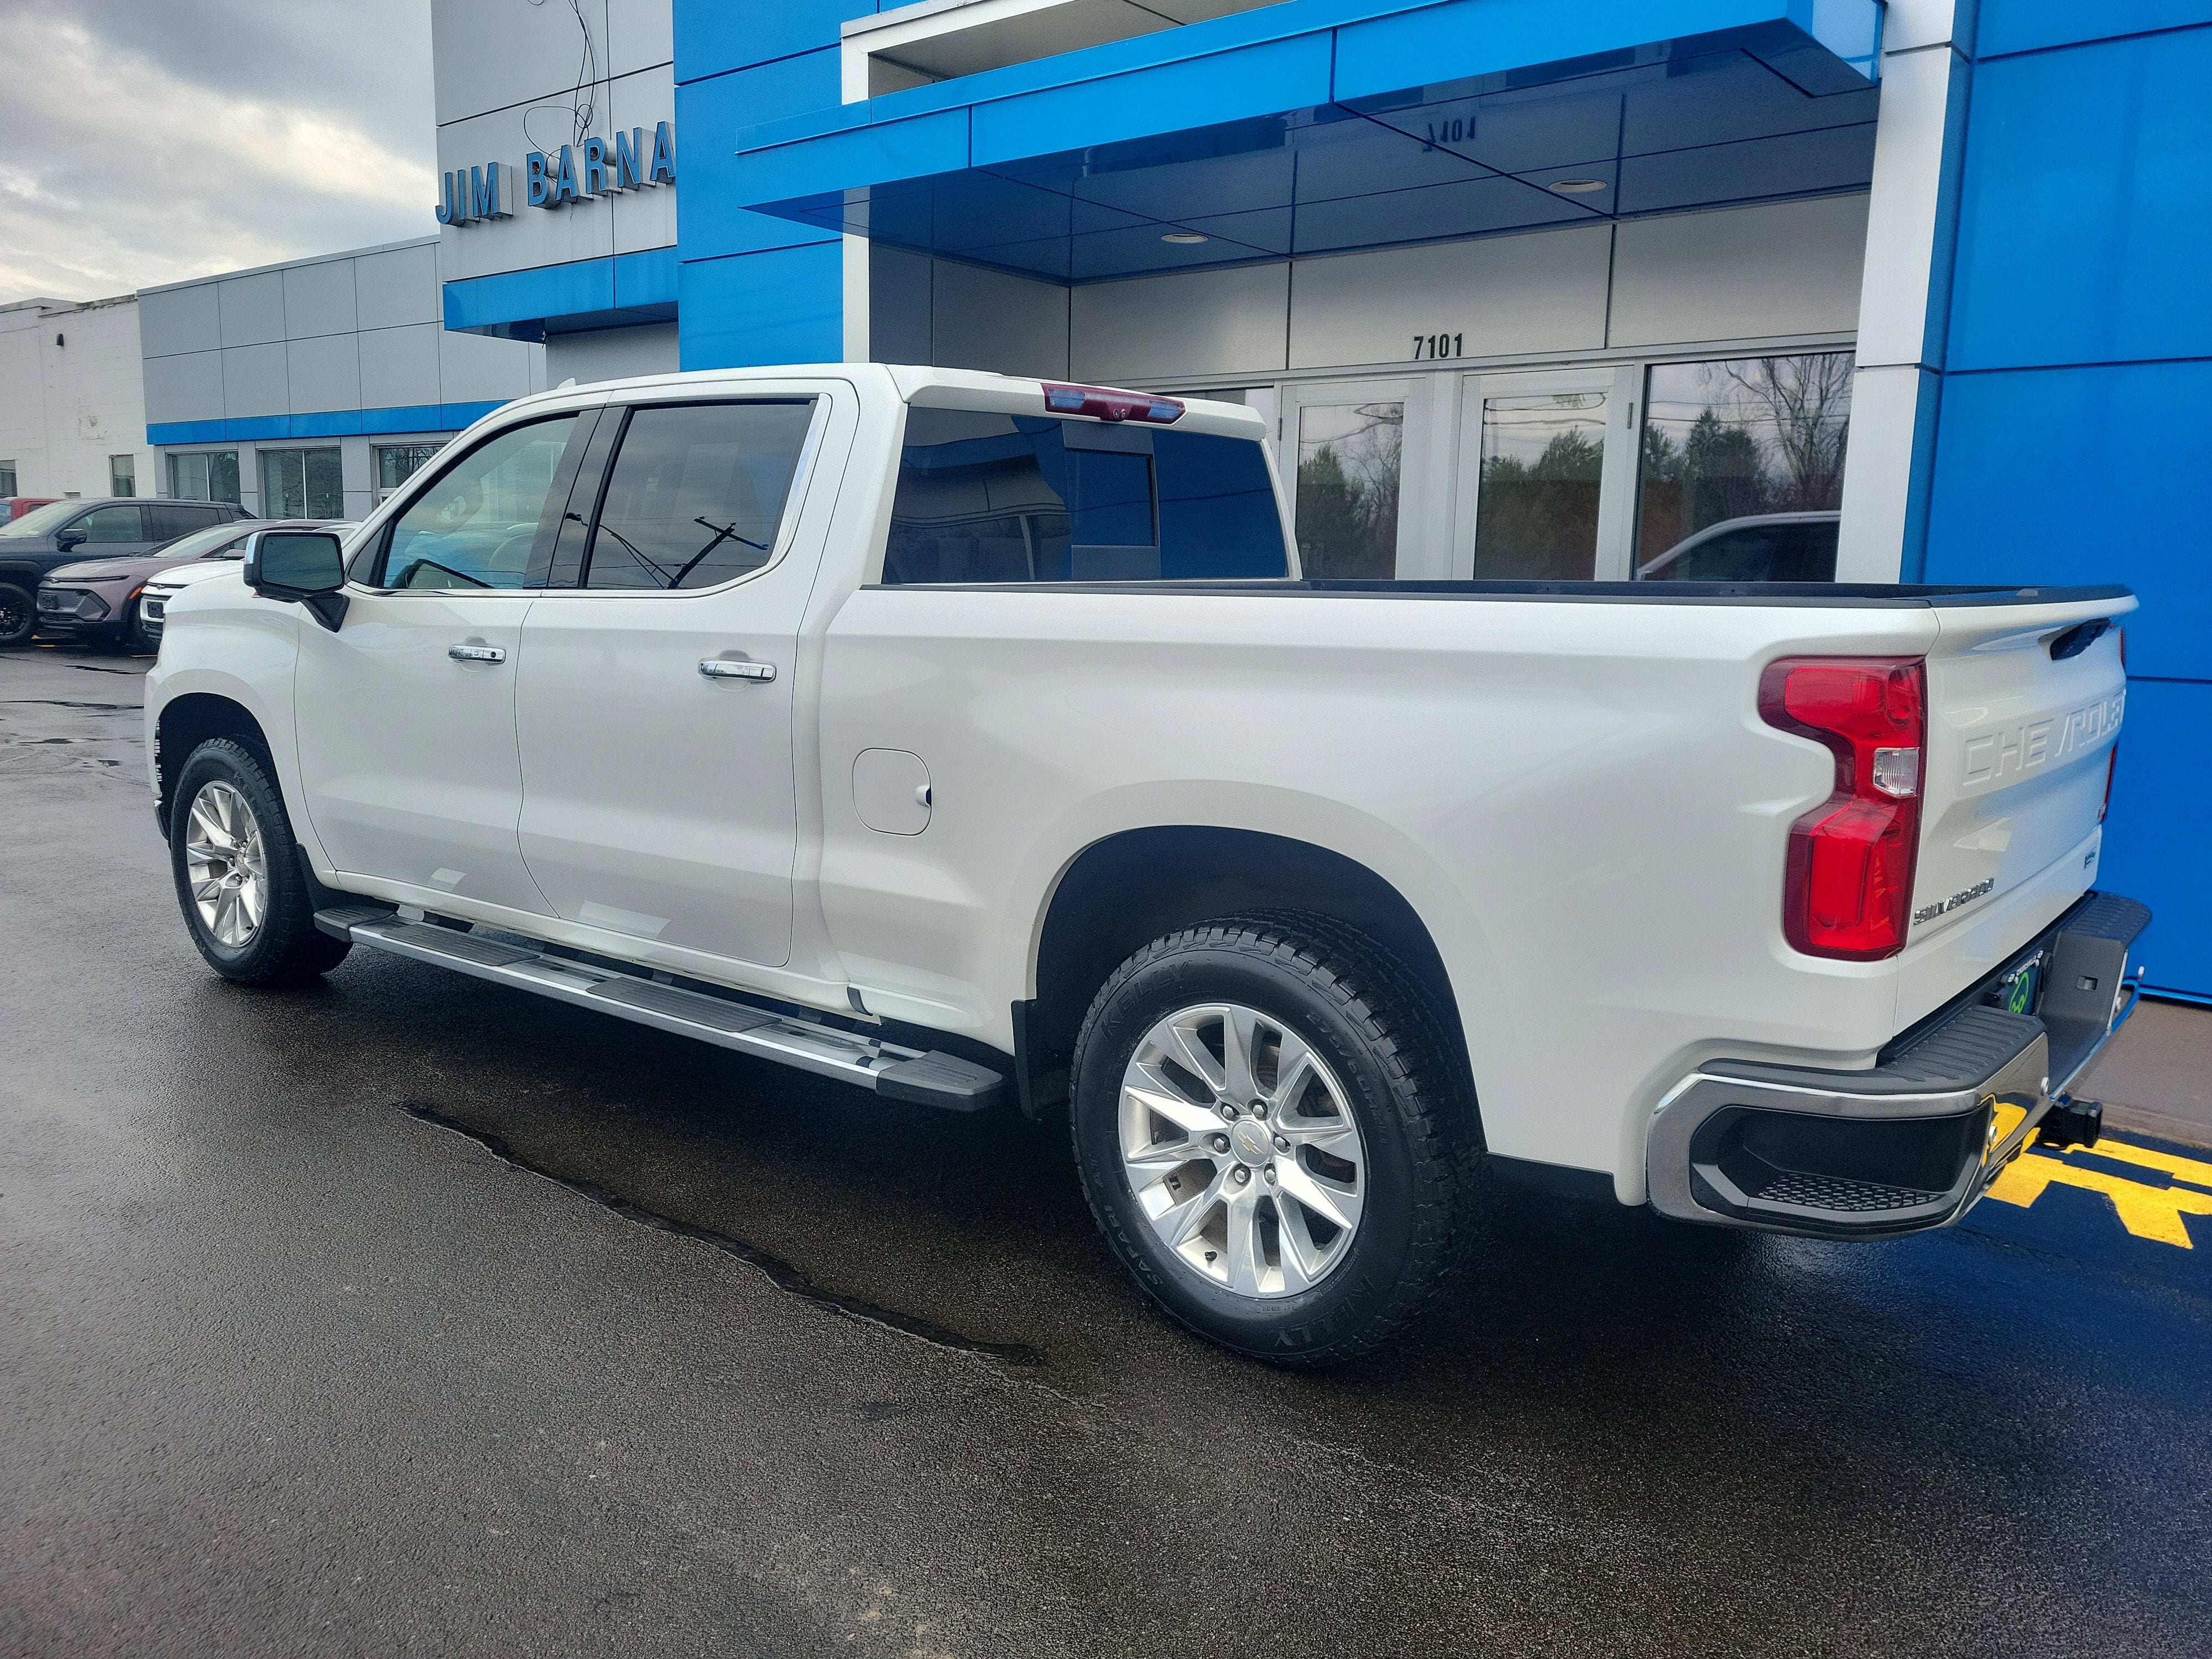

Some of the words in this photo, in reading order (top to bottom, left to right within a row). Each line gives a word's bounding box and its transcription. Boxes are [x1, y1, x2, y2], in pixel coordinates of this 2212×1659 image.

[435, 162, 504, 226] JIM
[1414, 333, 1462, 359] 7101
[1962, 690, 2125, 786] CHEVROLE
